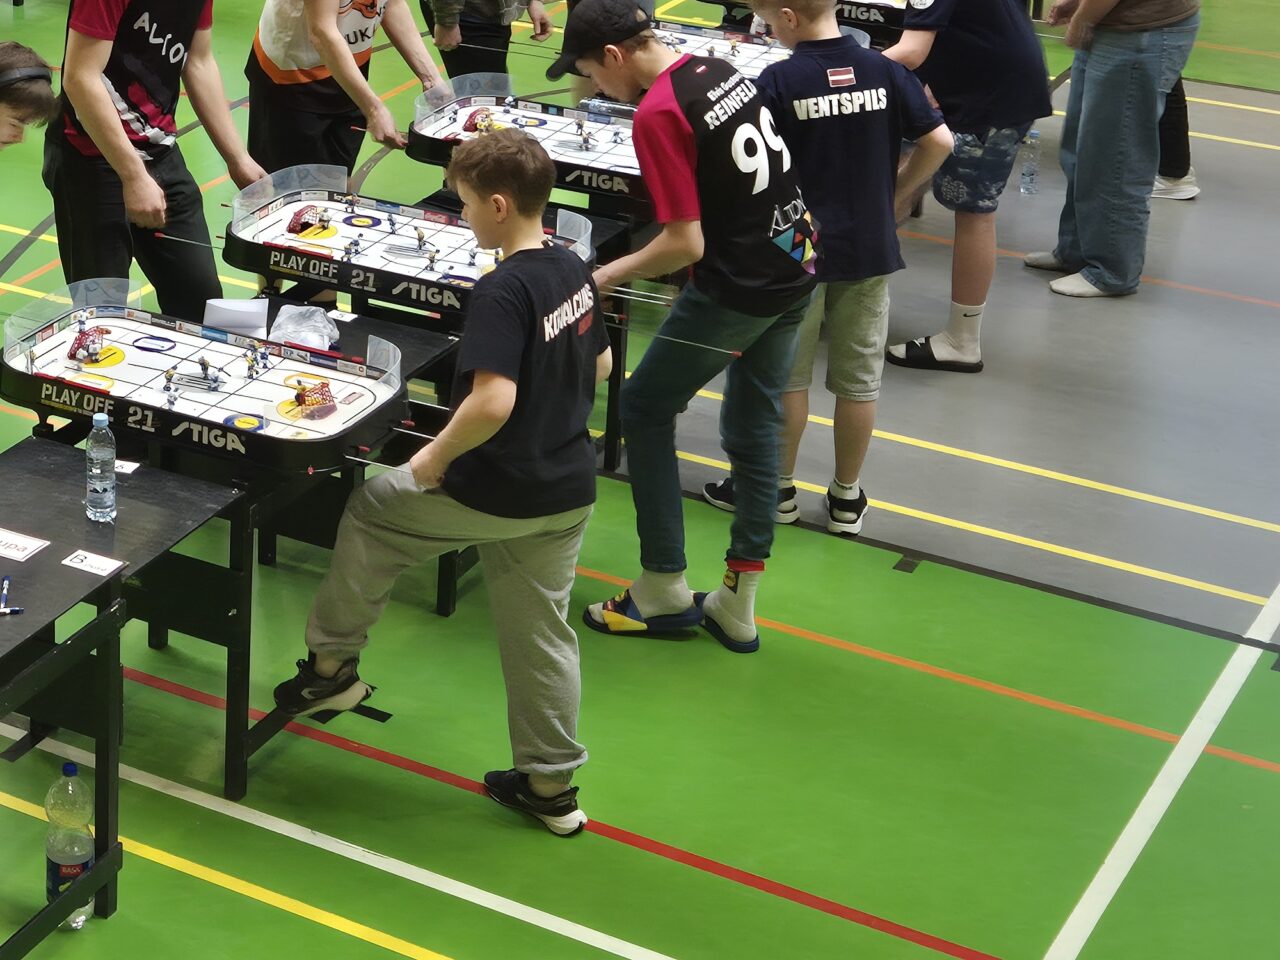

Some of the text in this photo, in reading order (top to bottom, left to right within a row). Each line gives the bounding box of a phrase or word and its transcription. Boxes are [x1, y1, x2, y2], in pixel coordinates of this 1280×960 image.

[133, 11, 188, 71] ALTO
[793, 87, 888, 121] VENTSPILS
[731, 105, 792, 195] 99
[565, 169, 629, 193] STIGA
[270, 250, 306, 273] PLAY
[308, 256, 339, 279] OFF
[350, 269, 378, 293] 21
[391, 281, 461, 310] STIGA
[40, 383, 82, 407] PLAY
[83, 393, 115, 413] OFF
[127, 405, 156, 433] 21
[171, 421, 247, 455] STIGA
[69, 553, 88, 564] B
